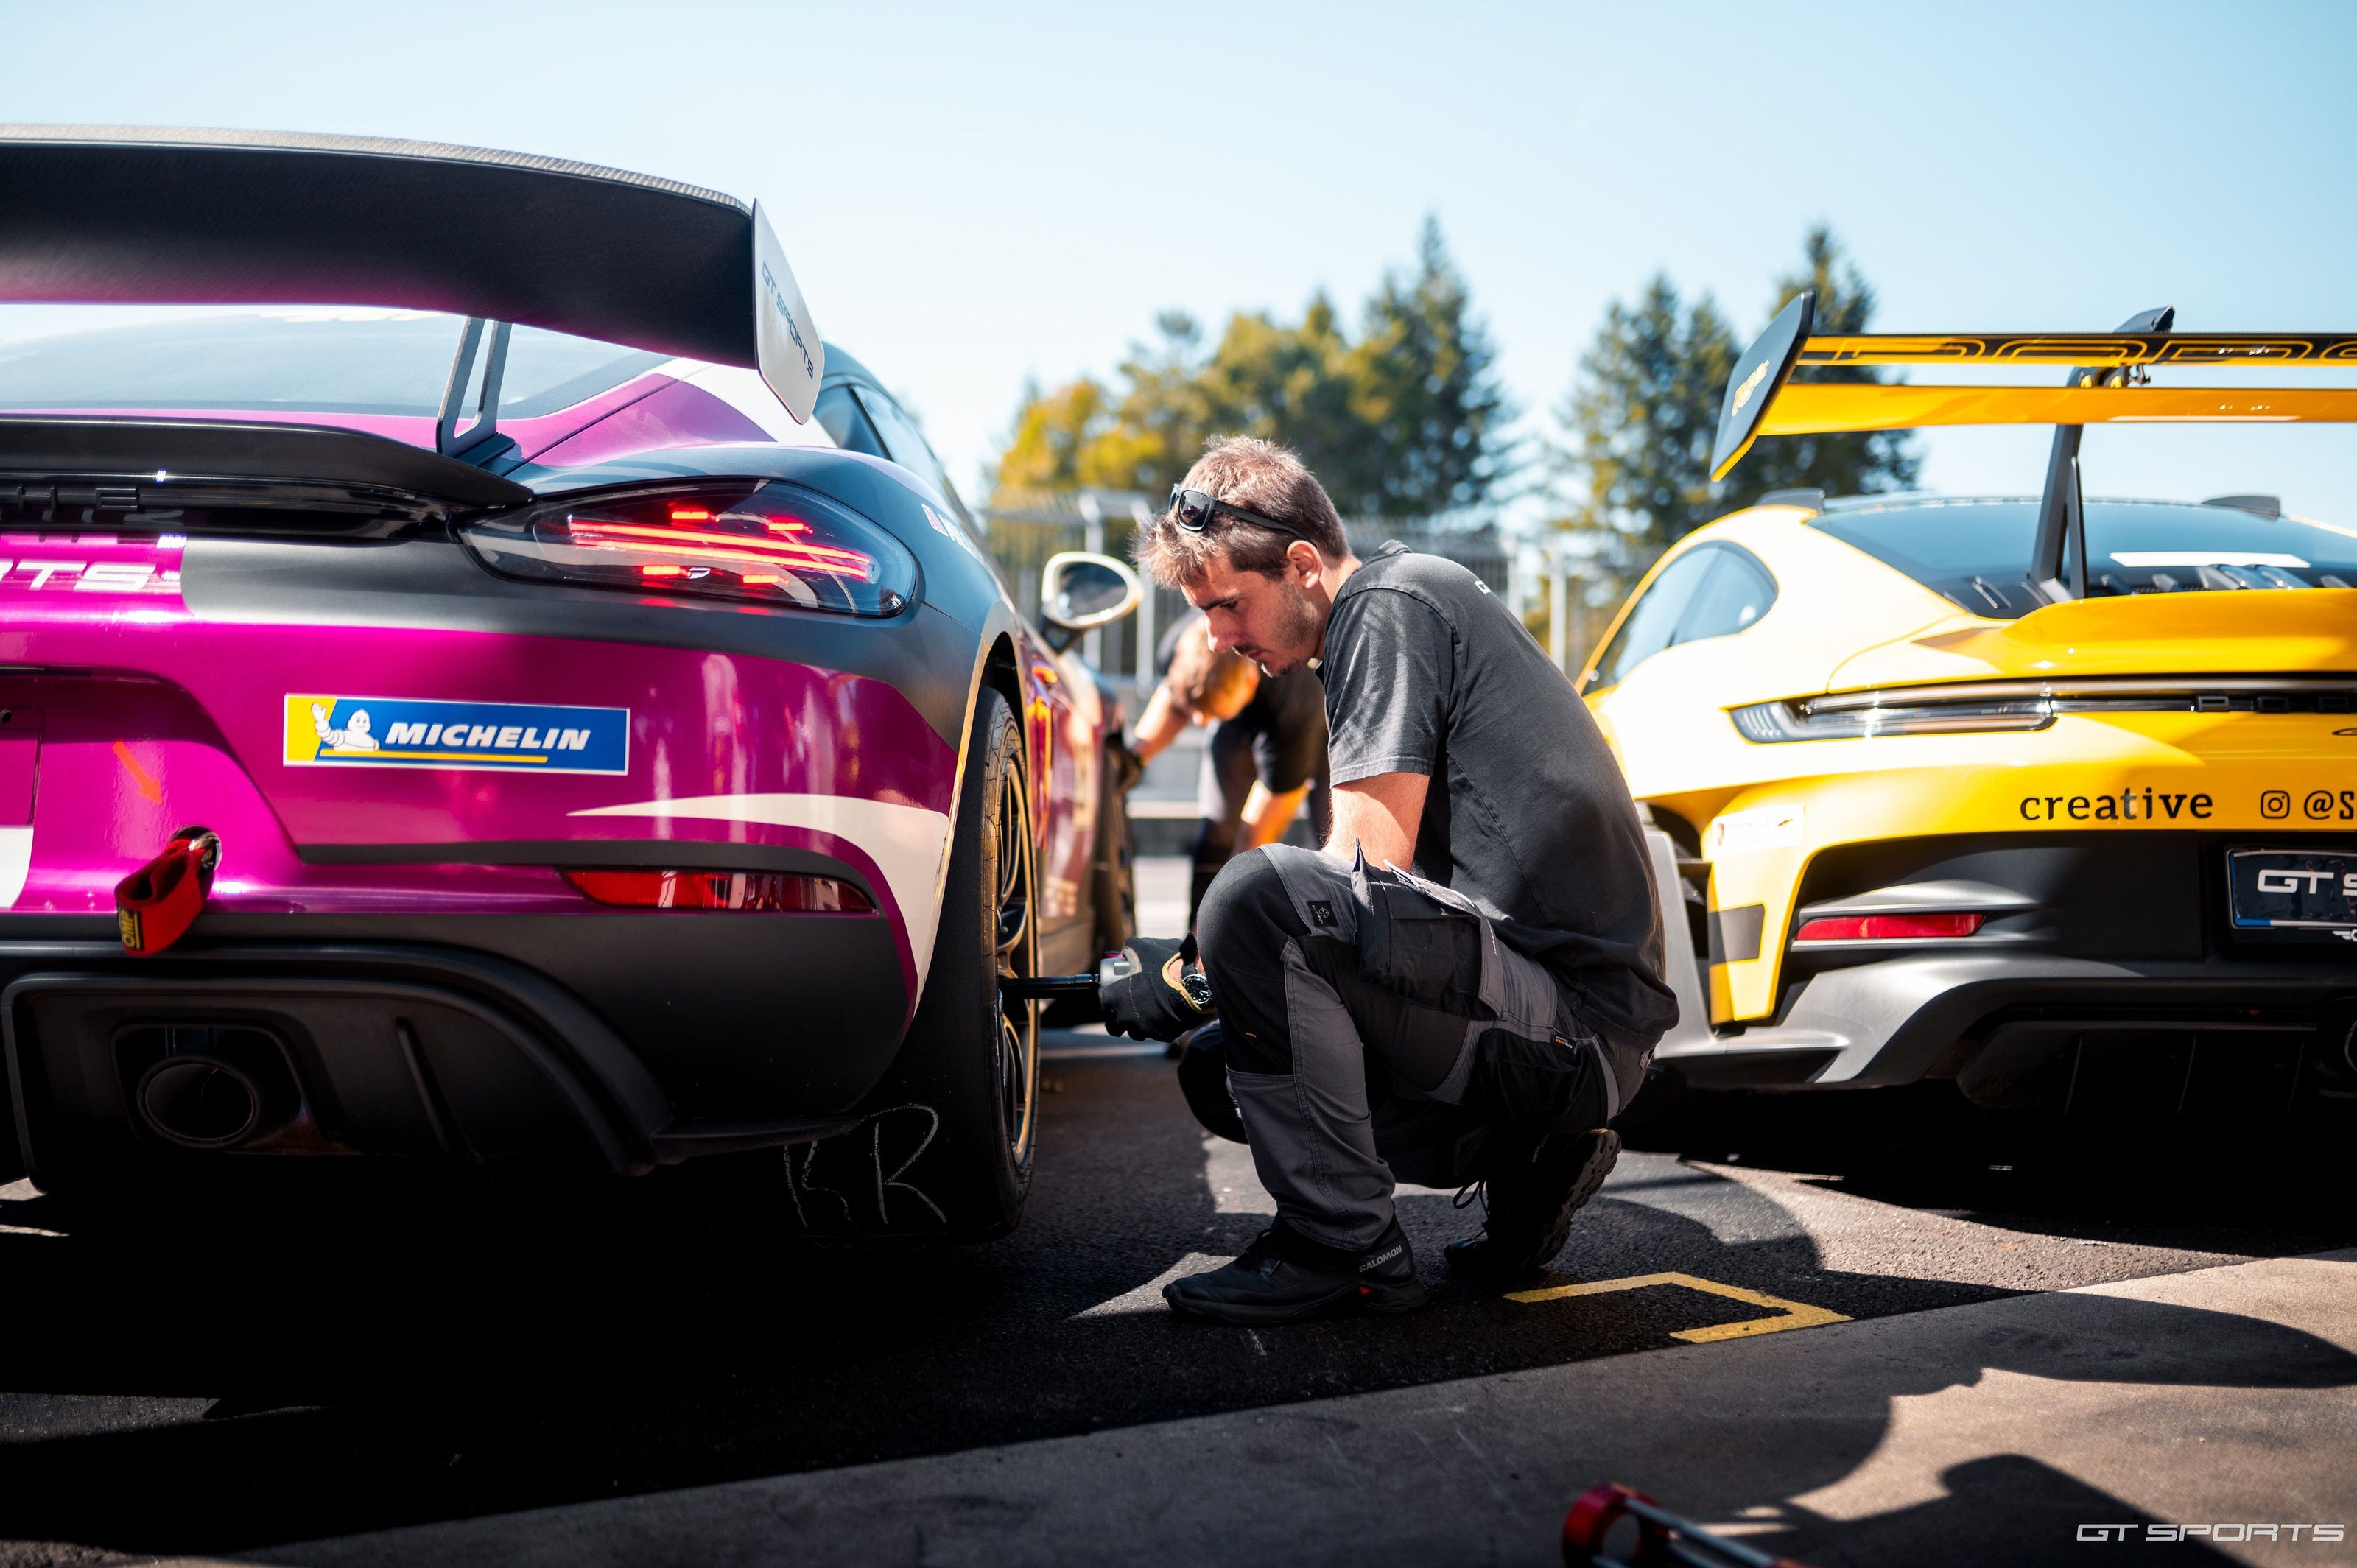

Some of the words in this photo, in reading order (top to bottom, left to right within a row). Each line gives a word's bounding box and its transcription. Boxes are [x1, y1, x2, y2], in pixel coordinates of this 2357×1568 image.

[762, 261, 776, 295] GT
[776, 291, 814, 380] SPORTS
[384, 722, 591, 750] MICHELIN
[2020, 787, 2213, 820] creative
[2258, 869, 2334, 894] GT
[1359, 1245, 1402, 1273] SALOMON
